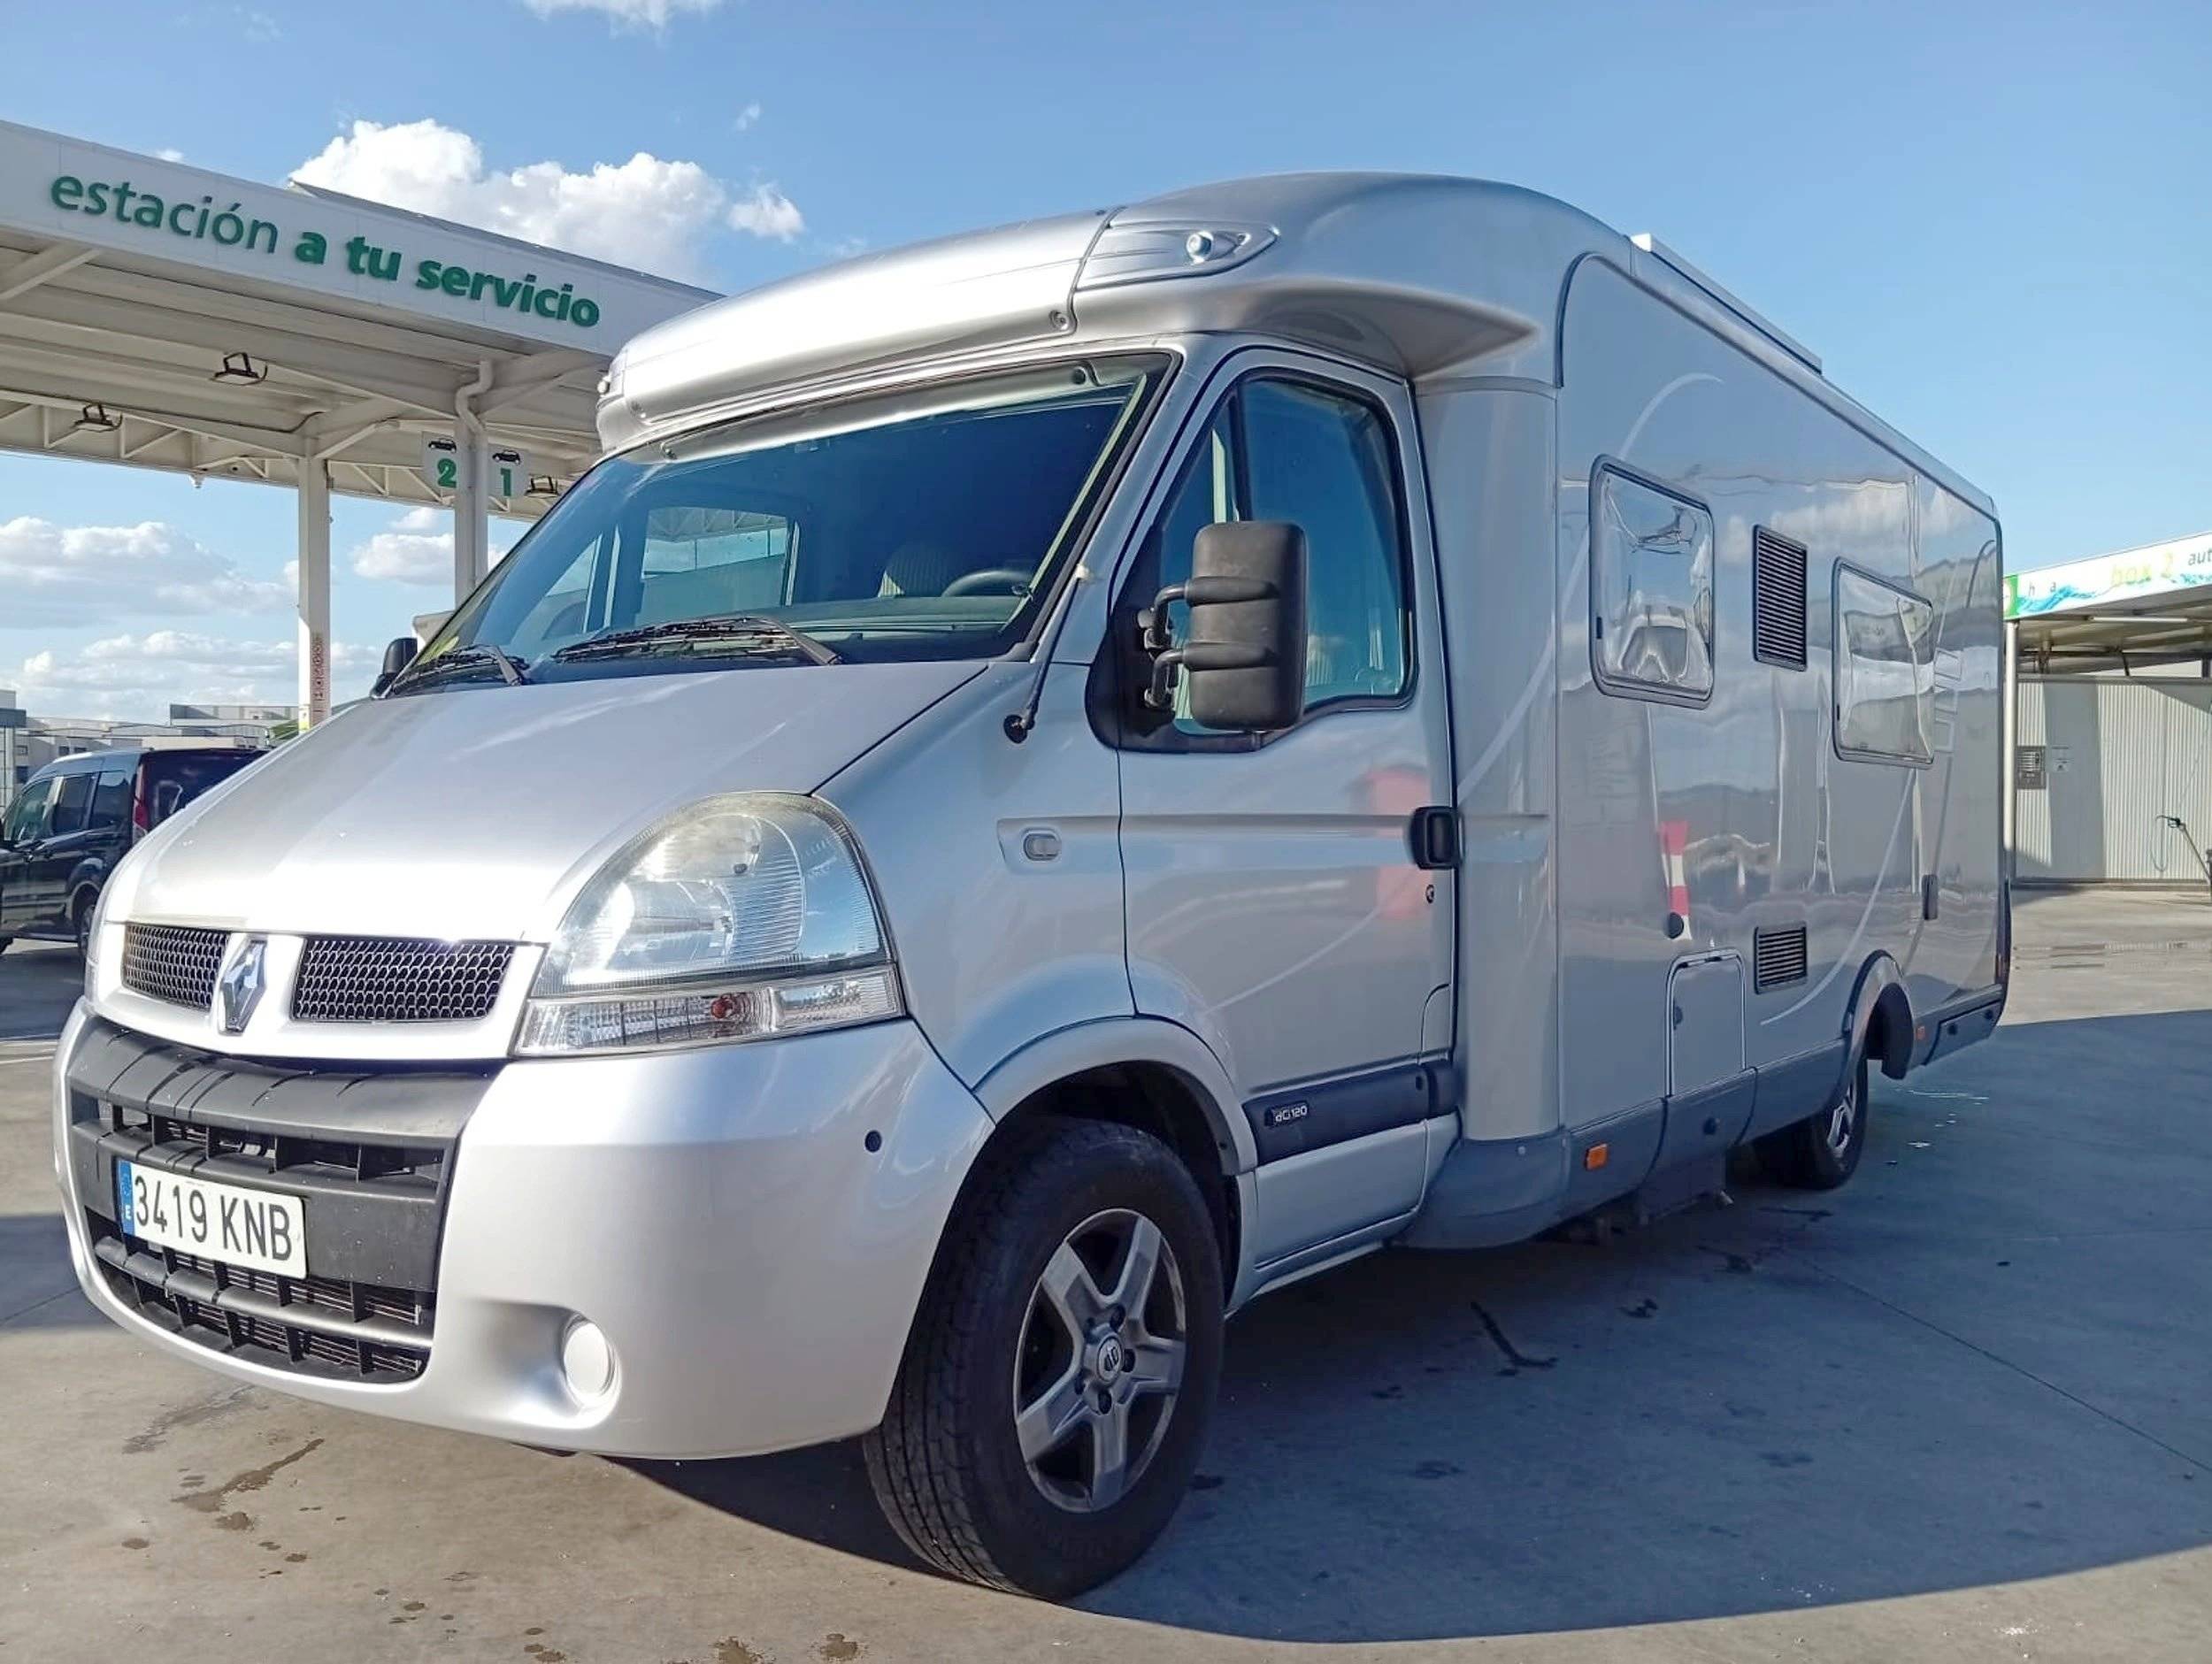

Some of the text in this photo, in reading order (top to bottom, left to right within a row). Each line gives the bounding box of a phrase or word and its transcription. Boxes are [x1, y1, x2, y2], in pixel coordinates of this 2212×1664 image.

[50, 175, 601, 327] estación a tu servicio
[437, 458, 457, 488] 2
[500, 467, 511, 497] 1
[124, 1204, 133, 1220] E
[134, 1175, 292, 1261] 3419 KNB
